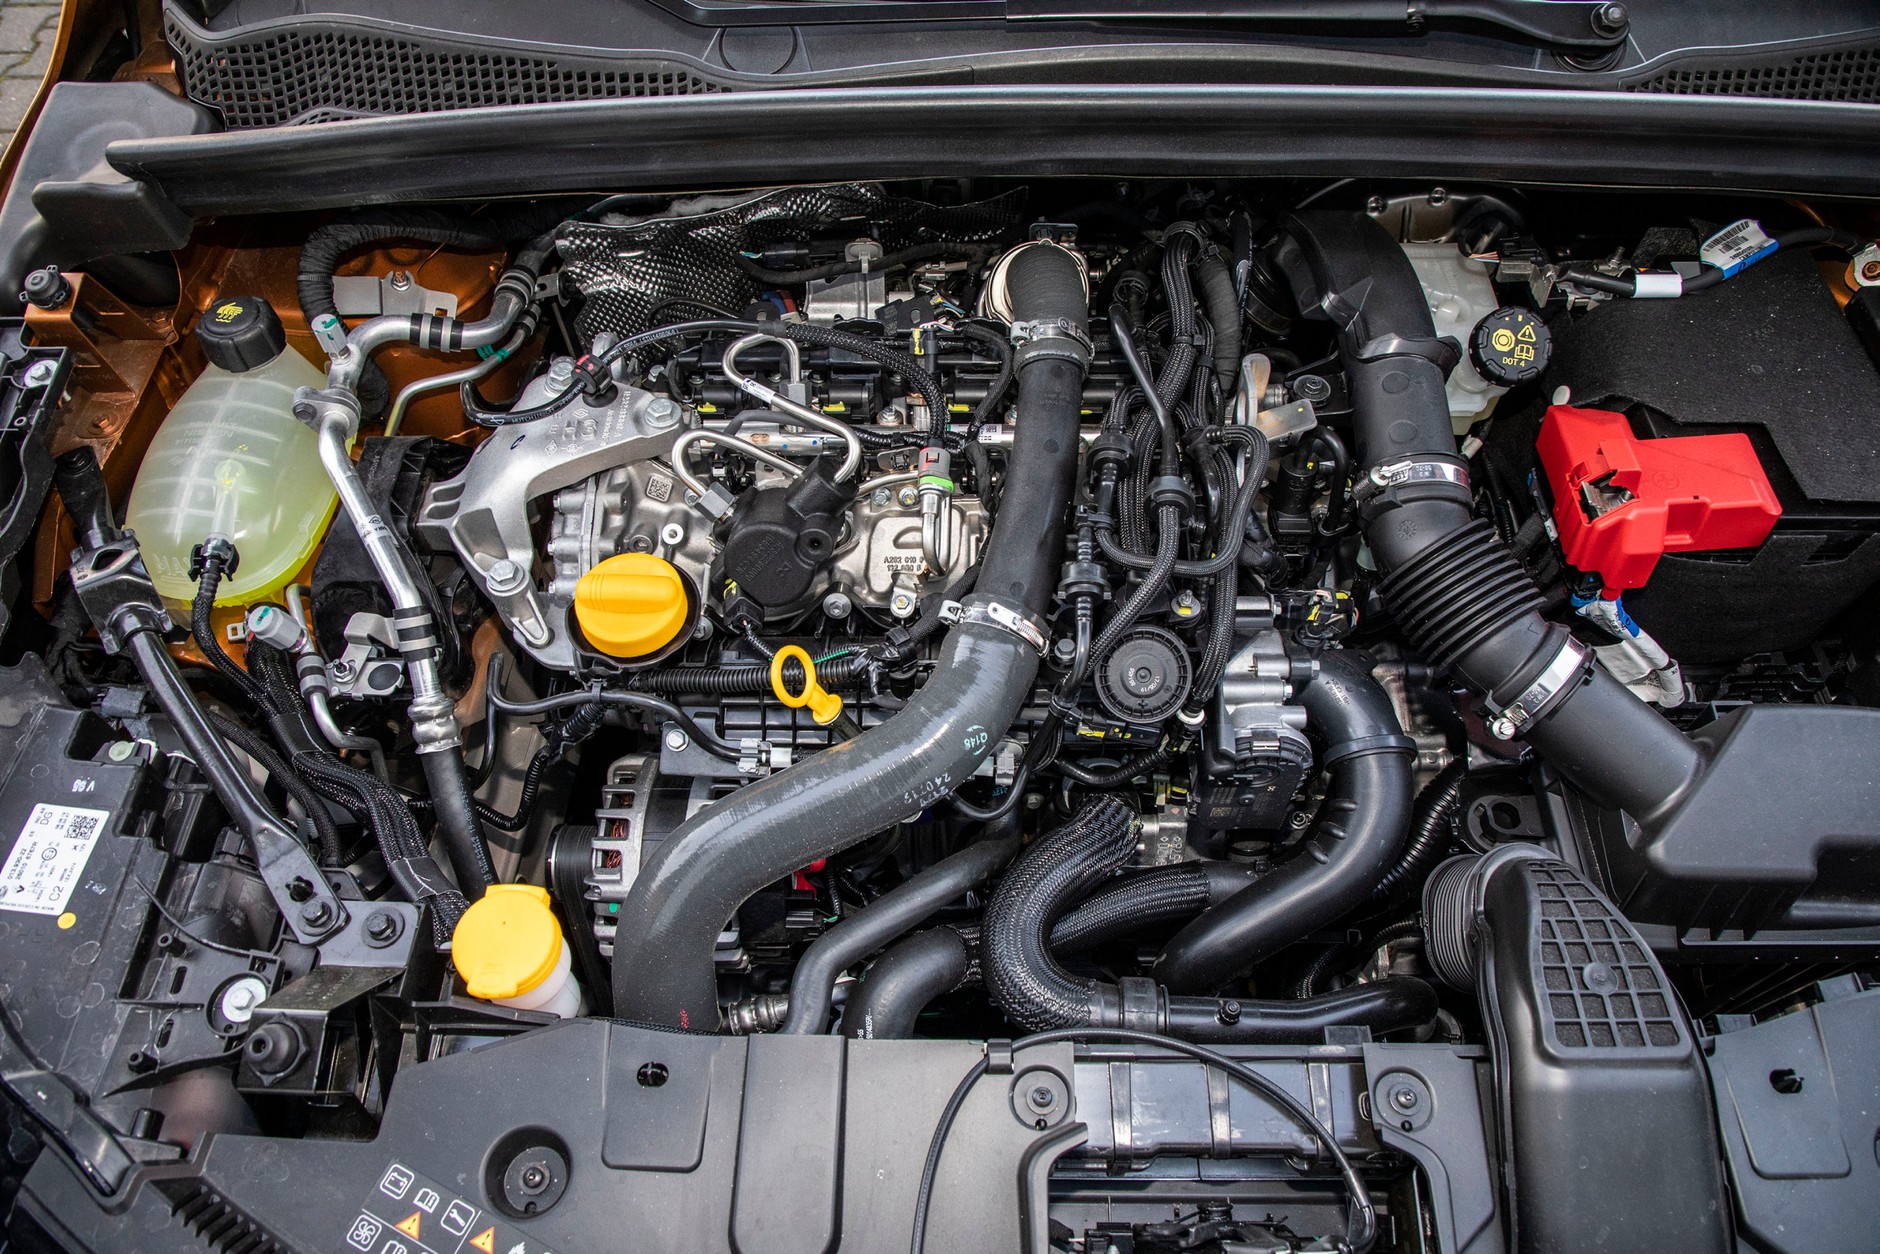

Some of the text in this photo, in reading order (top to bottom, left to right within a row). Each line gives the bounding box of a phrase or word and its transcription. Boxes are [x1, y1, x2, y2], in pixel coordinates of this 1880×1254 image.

[1502, 356, 1526, 368] DOT 4
[511, 407, 555, 424] HUTCHINON
[39, 811, 53, 826] DG
[48, 885, 65, 902] C2
